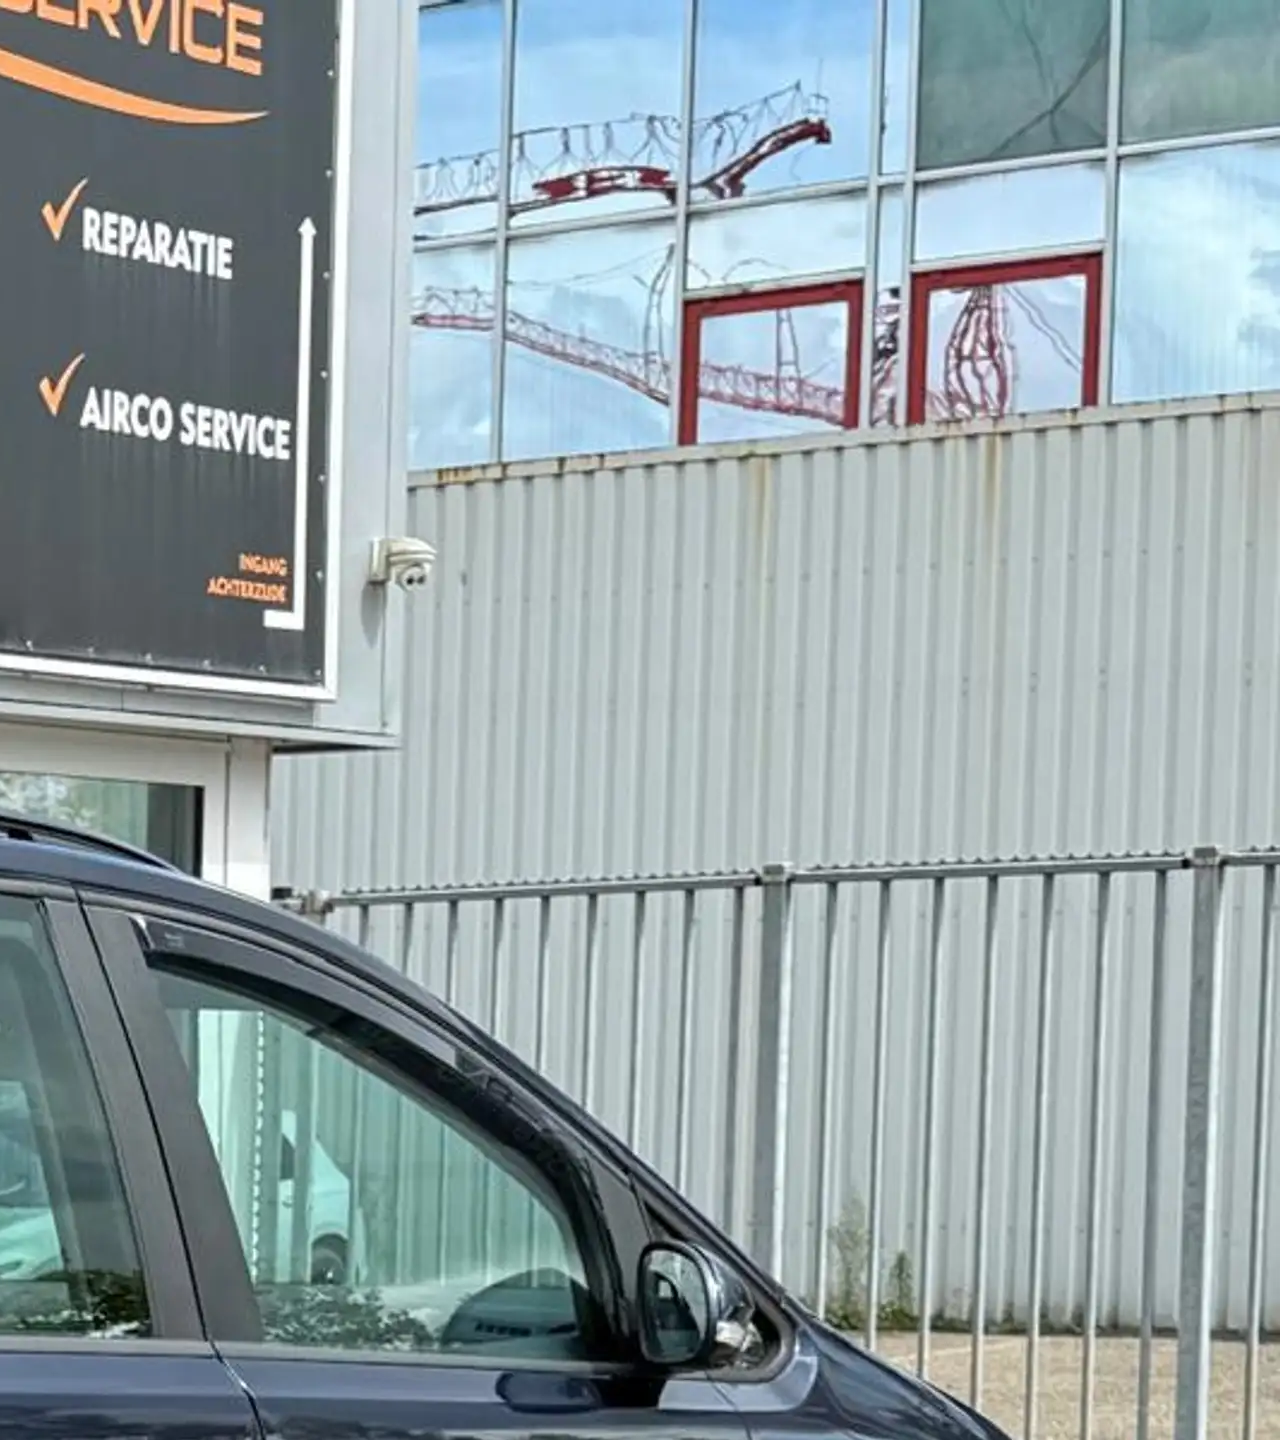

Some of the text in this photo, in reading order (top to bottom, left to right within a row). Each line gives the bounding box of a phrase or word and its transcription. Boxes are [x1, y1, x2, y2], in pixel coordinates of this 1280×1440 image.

[83, 207, 233, 279] REPARATIE
[80, 387, 291, 460] AIRCO SERVICE
[239, 553, 287, 576] INGANG
